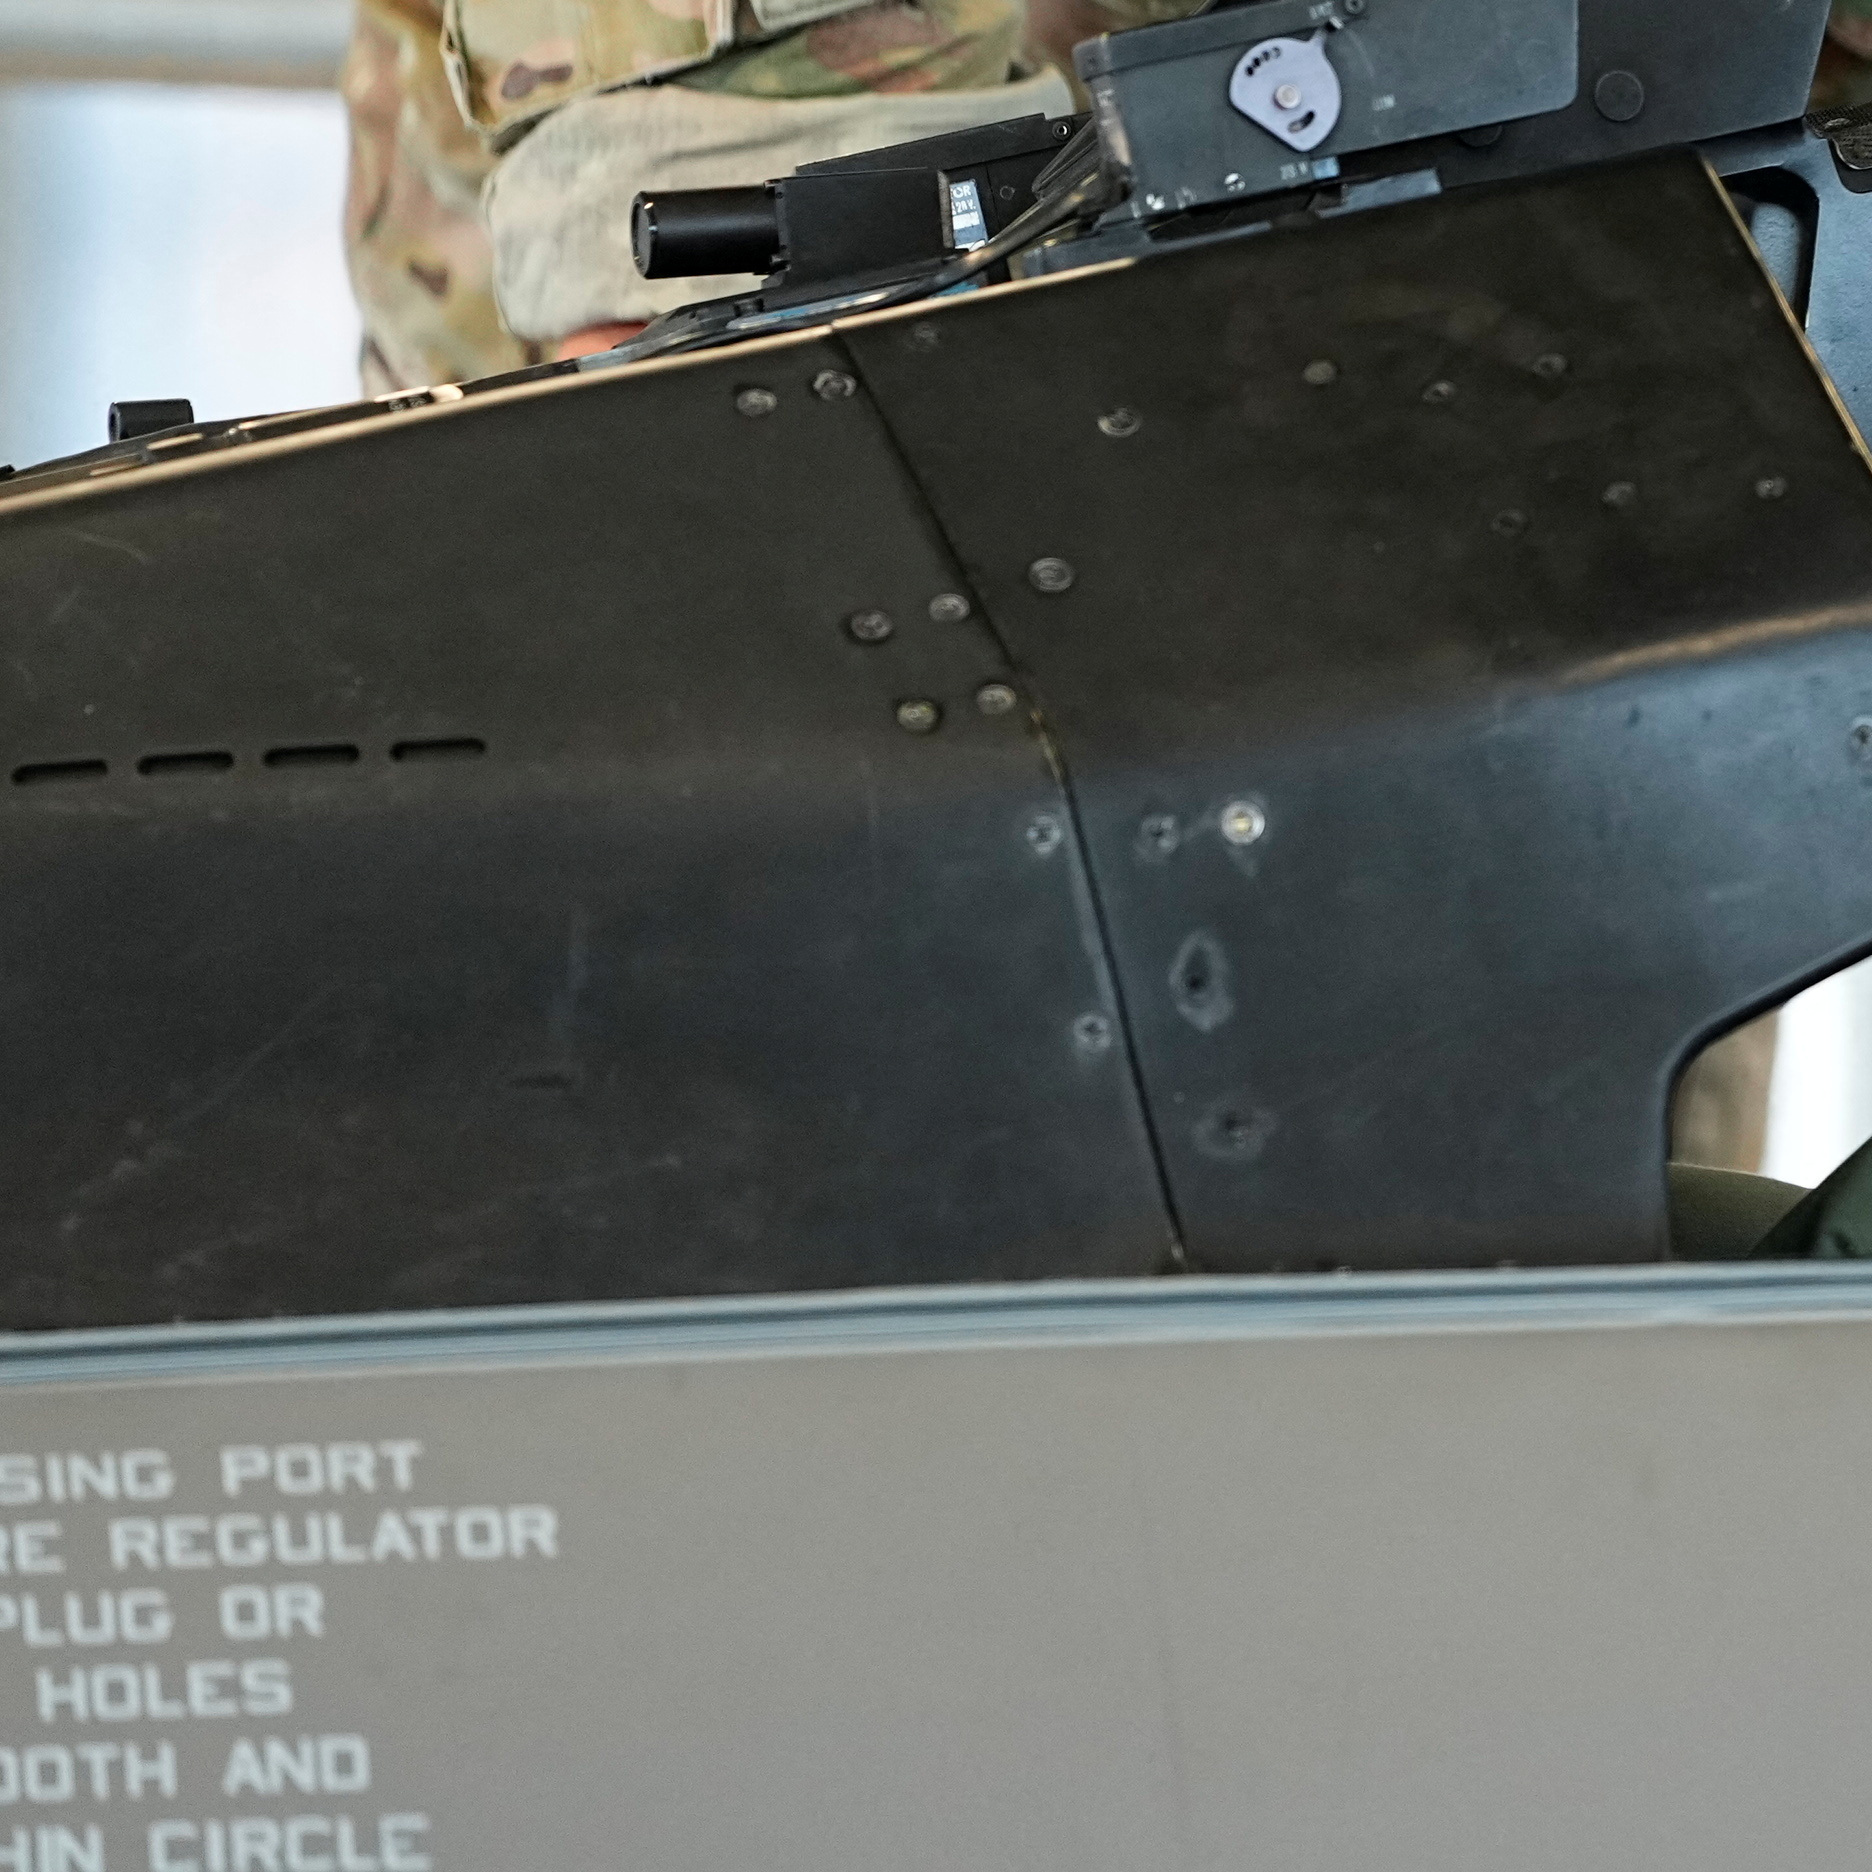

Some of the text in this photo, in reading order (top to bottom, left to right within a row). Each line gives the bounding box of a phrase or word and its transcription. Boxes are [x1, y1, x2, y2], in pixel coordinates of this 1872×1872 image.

[0, 1439, 423, 1506] SING PORT
[0, 1502, 558, 1573] E REGULATOR
[219, 1581, 325, 1640] OR
[35, 1659, 293, 1723] HOLES
[221, 1733, 373, 1797] AND
[150, 1812, 431, 1872] CIRCLE
